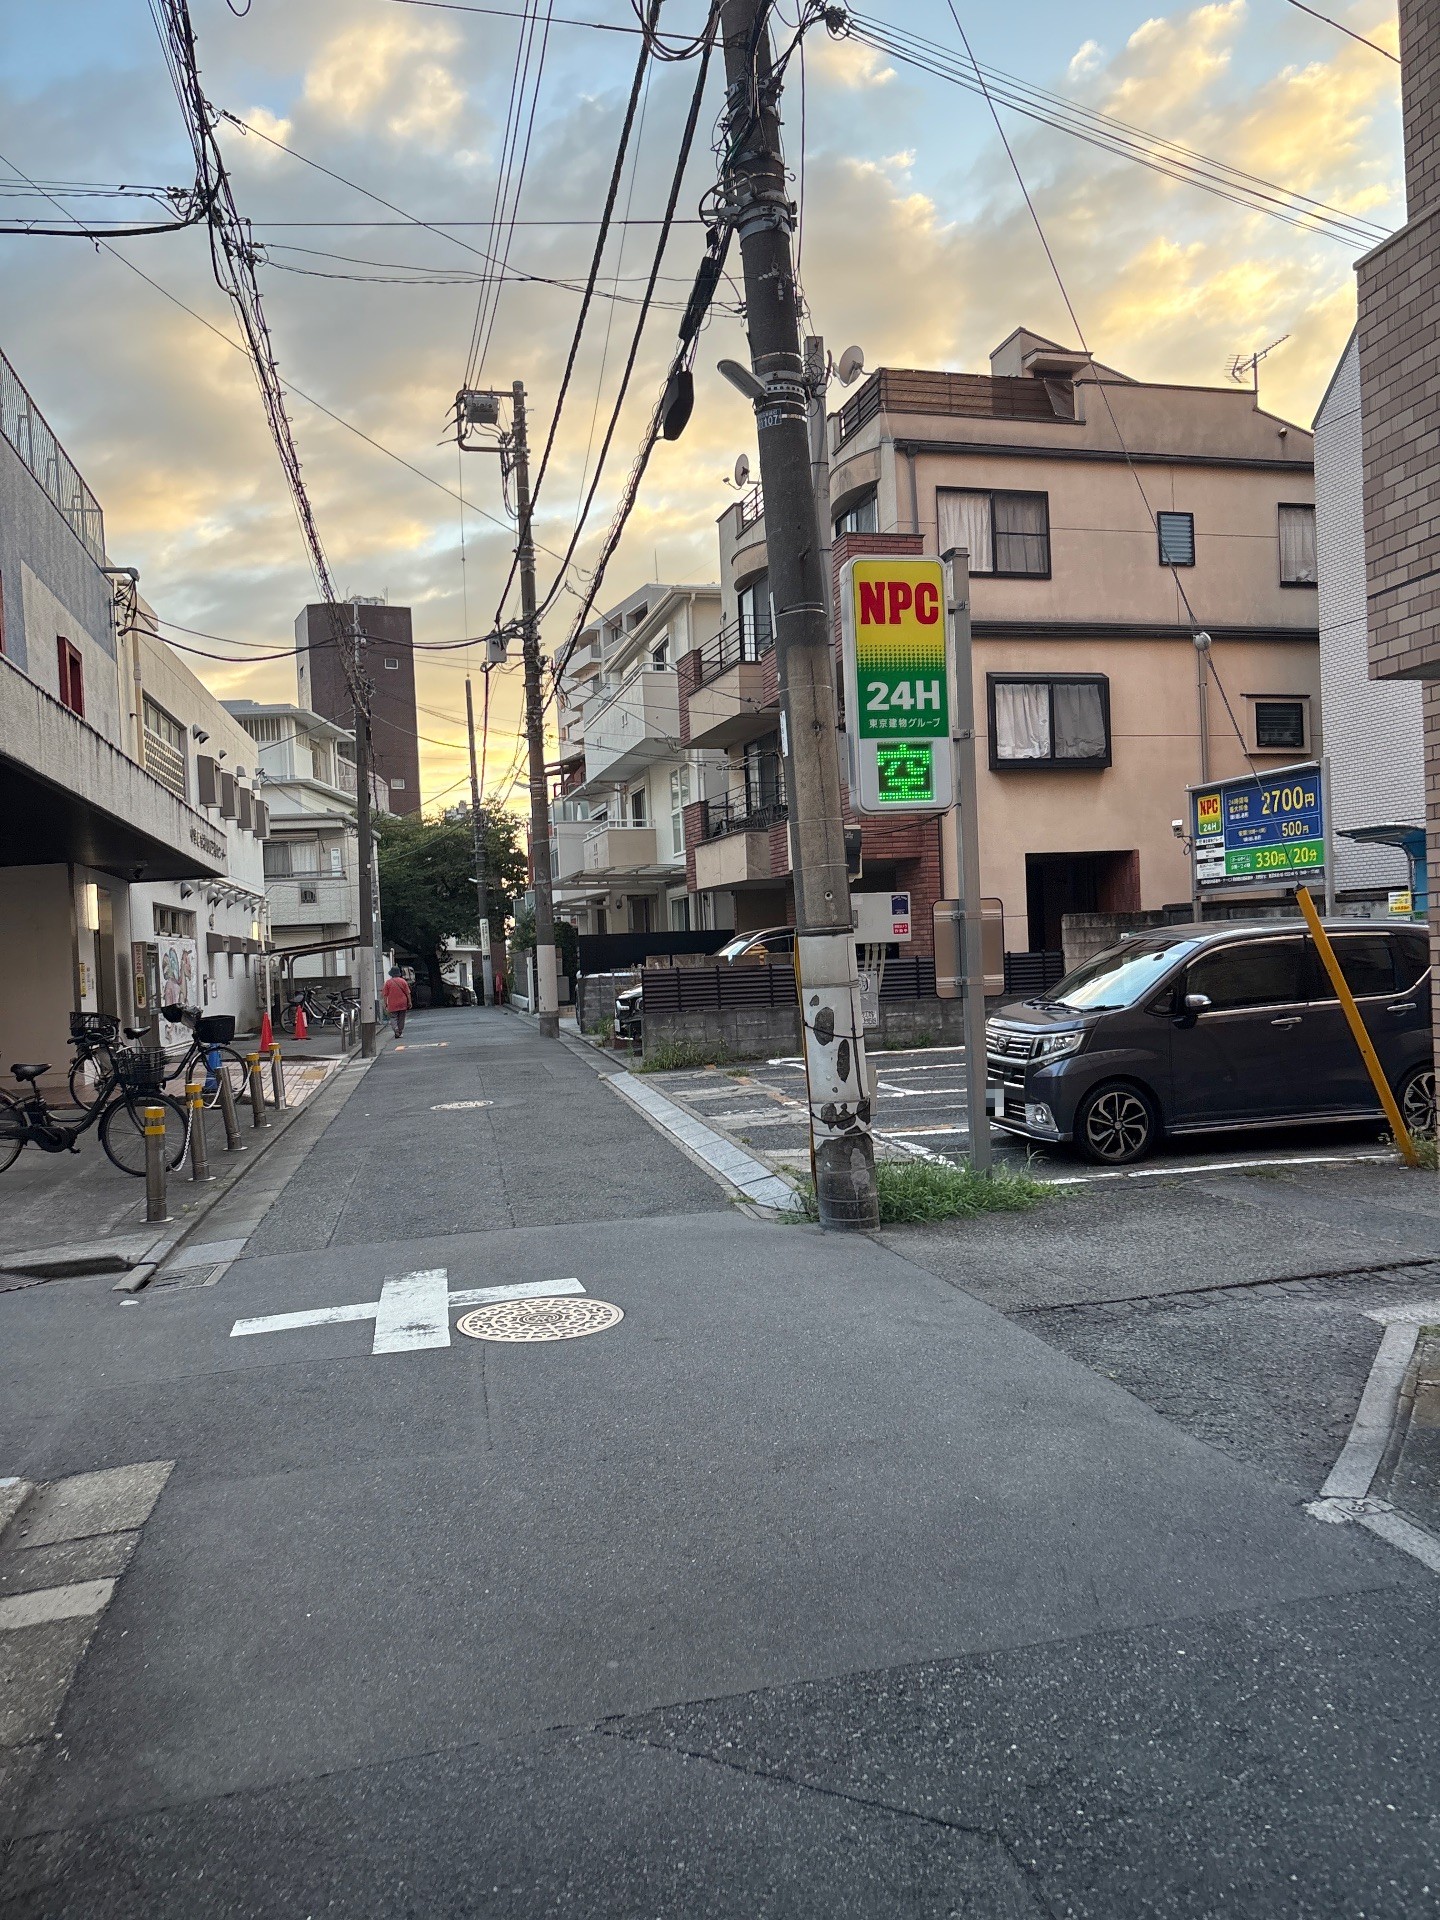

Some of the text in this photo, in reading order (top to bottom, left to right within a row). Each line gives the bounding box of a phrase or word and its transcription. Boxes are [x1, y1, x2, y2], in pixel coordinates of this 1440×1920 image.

[859, 582, 939, 625] NPC
[866, 680, 941, 711] 24H
[868, 717, 940, 729] 東京建物グループ
[877, 743, 931, 801] 空
[1200, 798, 1219, 816] NPC
[1261, 786, 1315, 815] 2700円
[1203, 822, 1217, 832] 24H
[1281, 820, 1310, 837] 500円
